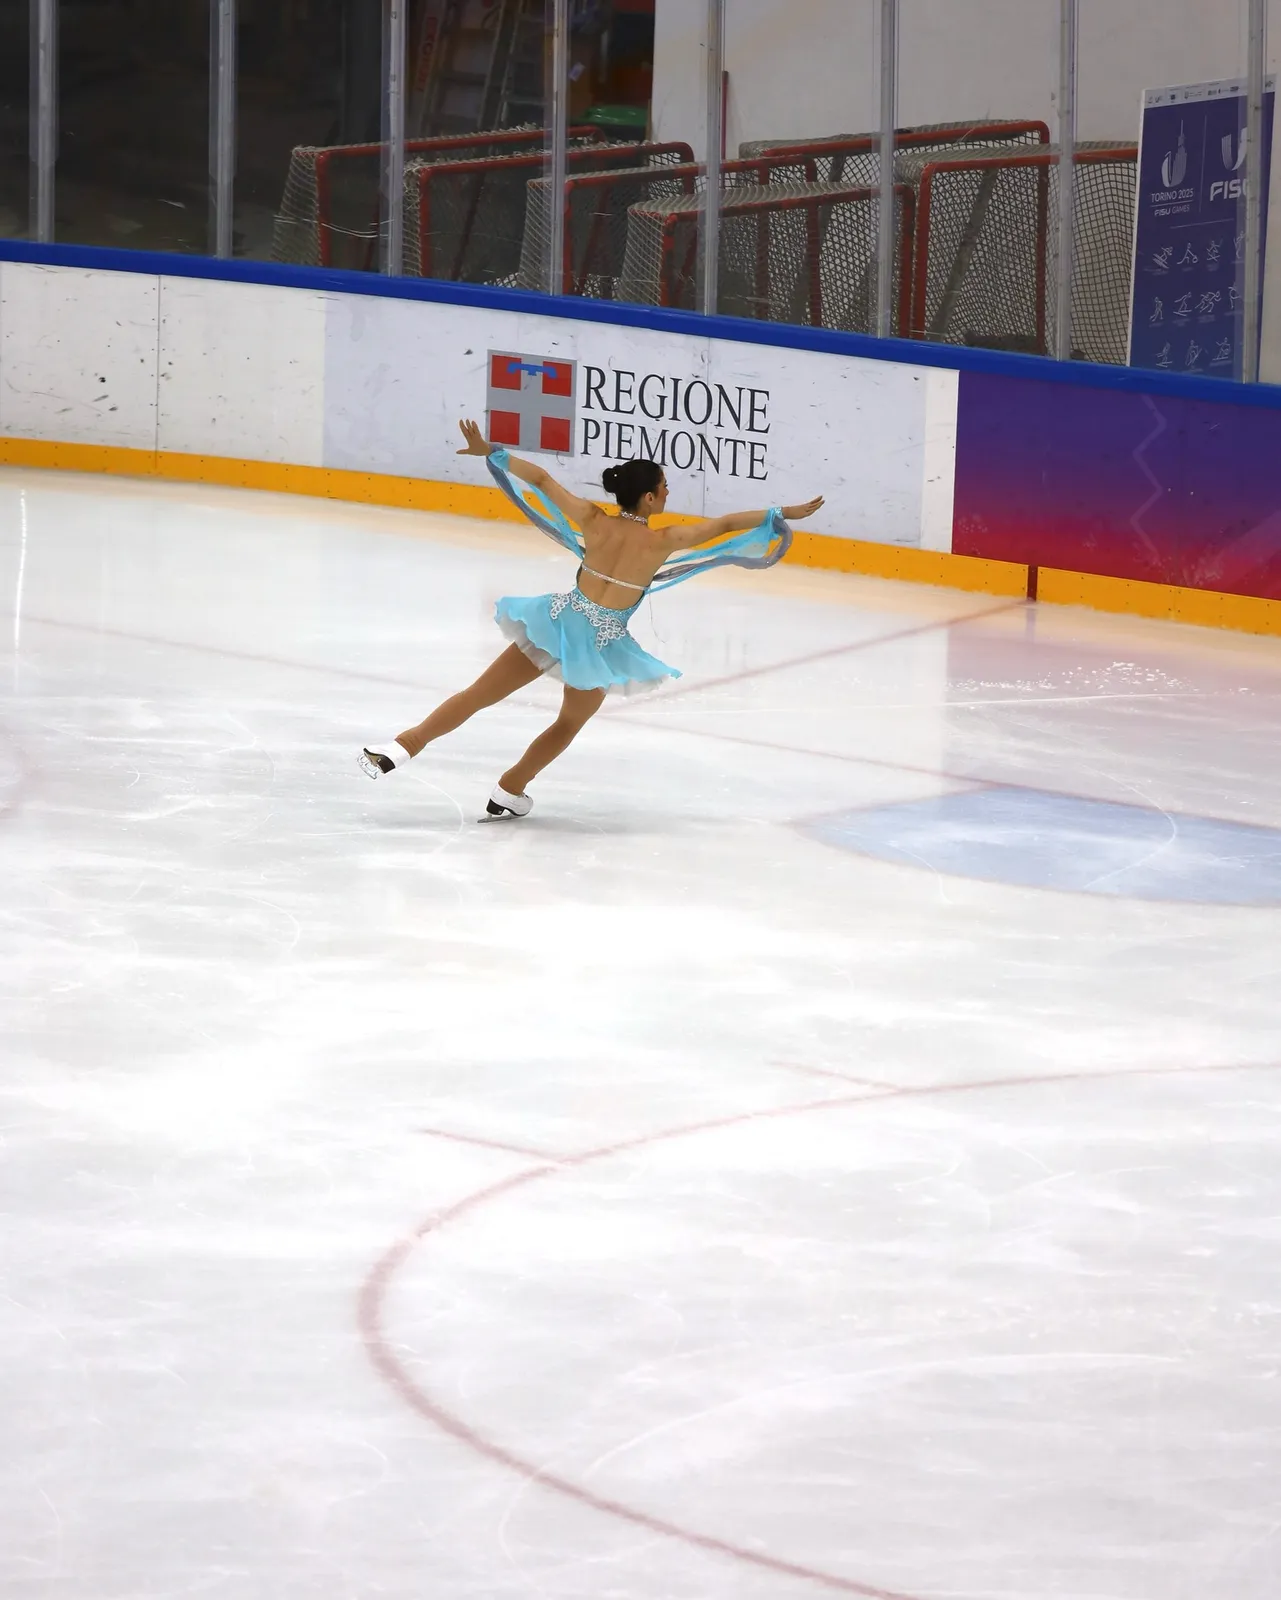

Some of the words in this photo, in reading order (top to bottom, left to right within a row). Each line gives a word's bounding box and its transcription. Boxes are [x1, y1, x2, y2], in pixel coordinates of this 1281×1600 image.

[1151, 190, 1177, 202] TORINO
[1178, 188, 1194, 199] 2025
[1154, 208, 1171, 216] FISU
[1172, 205, 1190, 213] GAMES
[581, 365, 771, 434] REGIONE
[580, 417, 769, 481] PIEMONTE
